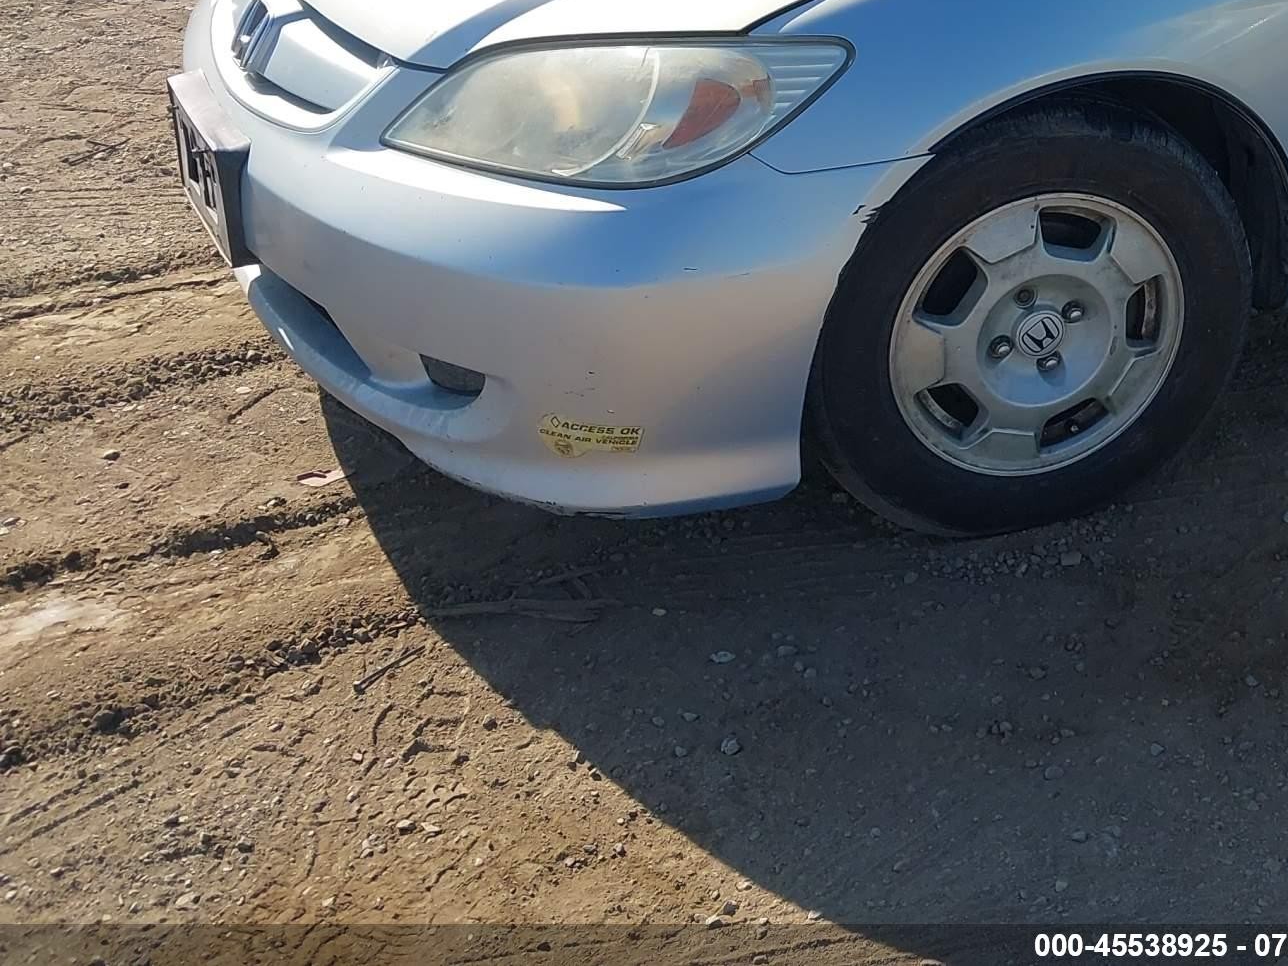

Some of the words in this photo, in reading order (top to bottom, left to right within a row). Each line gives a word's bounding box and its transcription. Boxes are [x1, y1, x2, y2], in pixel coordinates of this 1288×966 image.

[539, 428, 572, 440] CLEAN
[561, 421, 616, 435] ACCESS
[620, 427, 641, 435] OK
